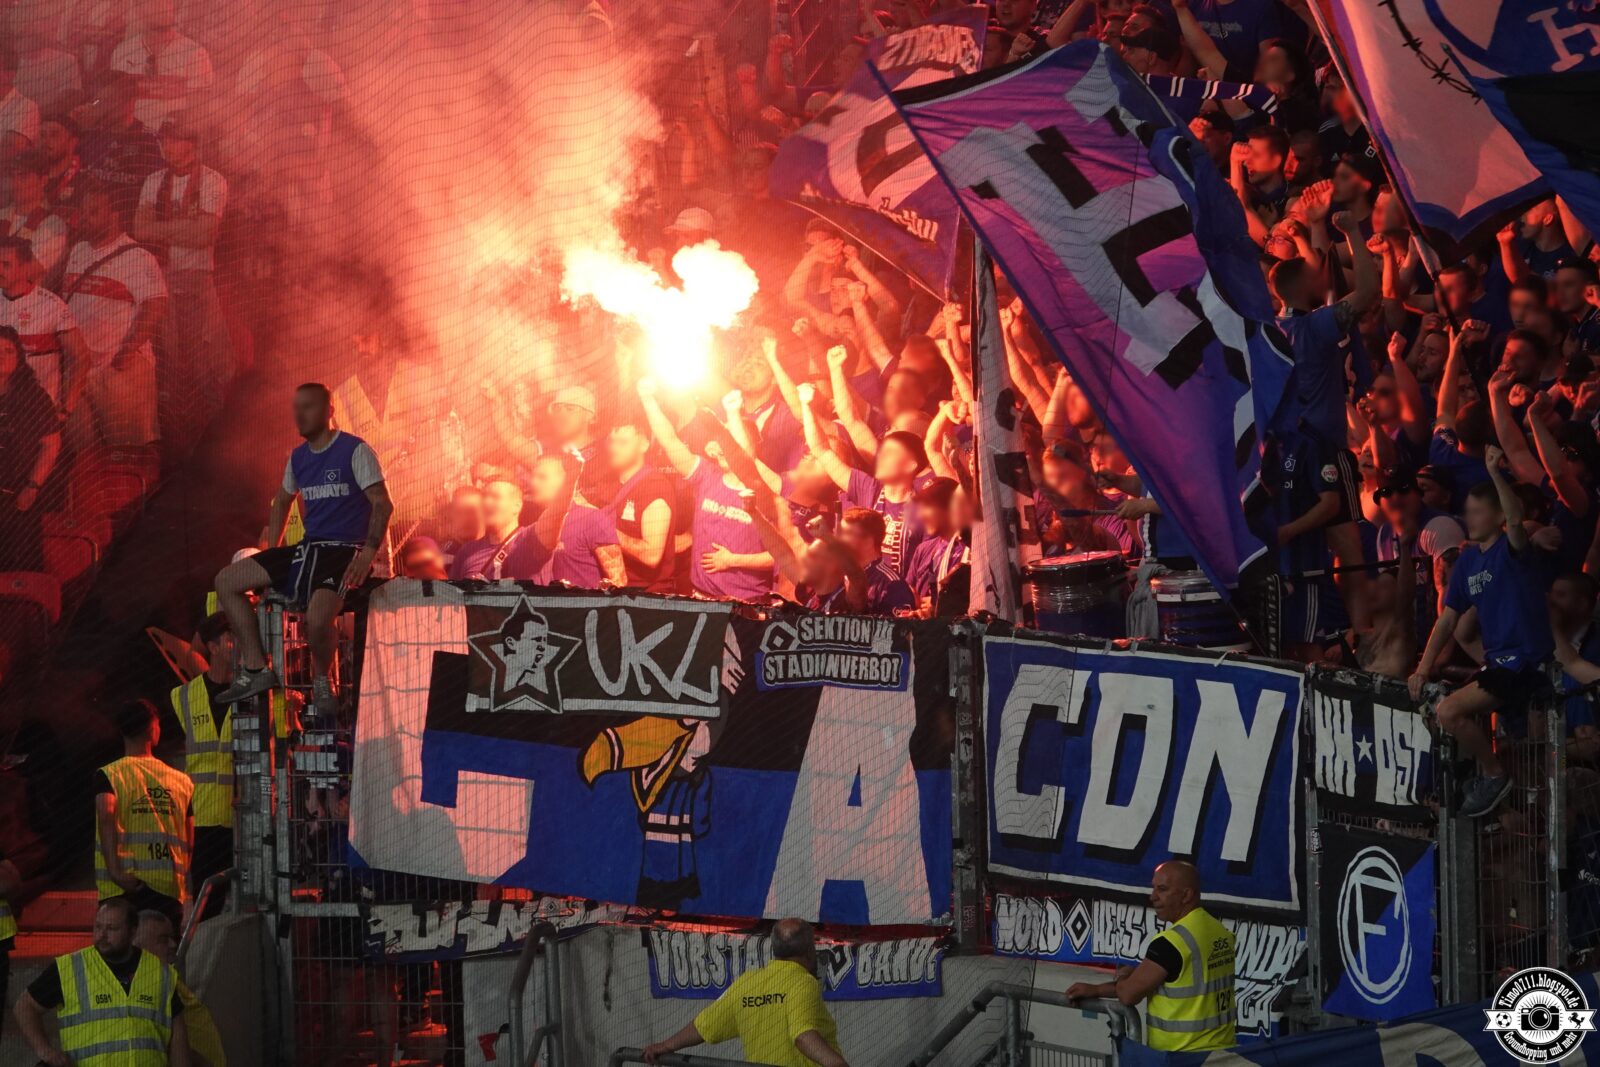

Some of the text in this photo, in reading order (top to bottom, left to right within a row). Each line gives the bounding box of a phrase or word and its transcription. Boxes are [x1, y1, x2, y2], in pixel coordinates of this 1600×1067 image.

[800, 616, 872, 645] SEKTION
[994, 663, 1287, 863] CDN
[148, 842, 170, 859] 184
[742, 993, 787, 1008] SECURITY
